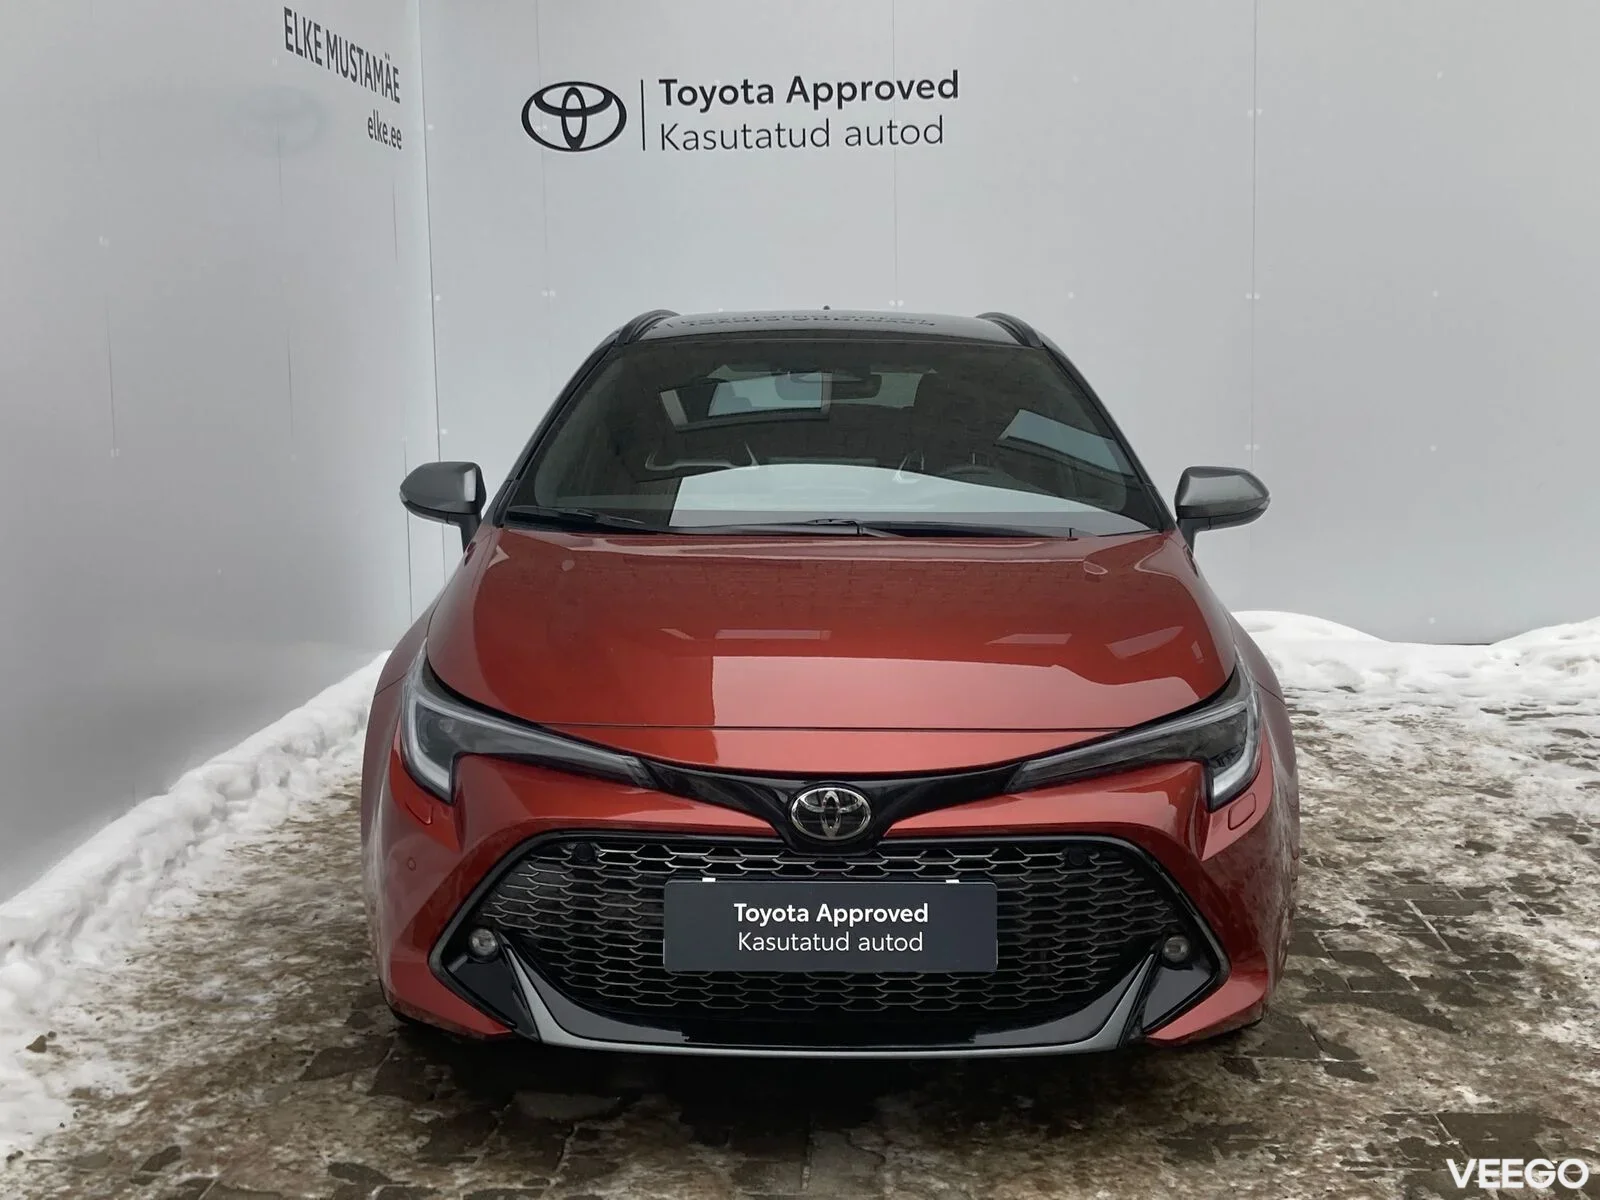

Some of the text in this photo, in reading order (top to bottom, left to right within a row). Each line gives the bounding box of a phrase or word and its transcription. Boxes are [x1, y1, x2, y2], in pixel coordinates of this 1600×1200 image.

[284, 7, 400, 104] ELKE MUSTAMÄE
[658, 69, 960, 113] Toyota Approved
[367, 109, 402, 150] elke.ee
[660, 114, 944, 151] Kasutatud autod
[733, 903, 929, 927] Toyota Approved
[738, 931, 923, 952] Kasutatud autod
